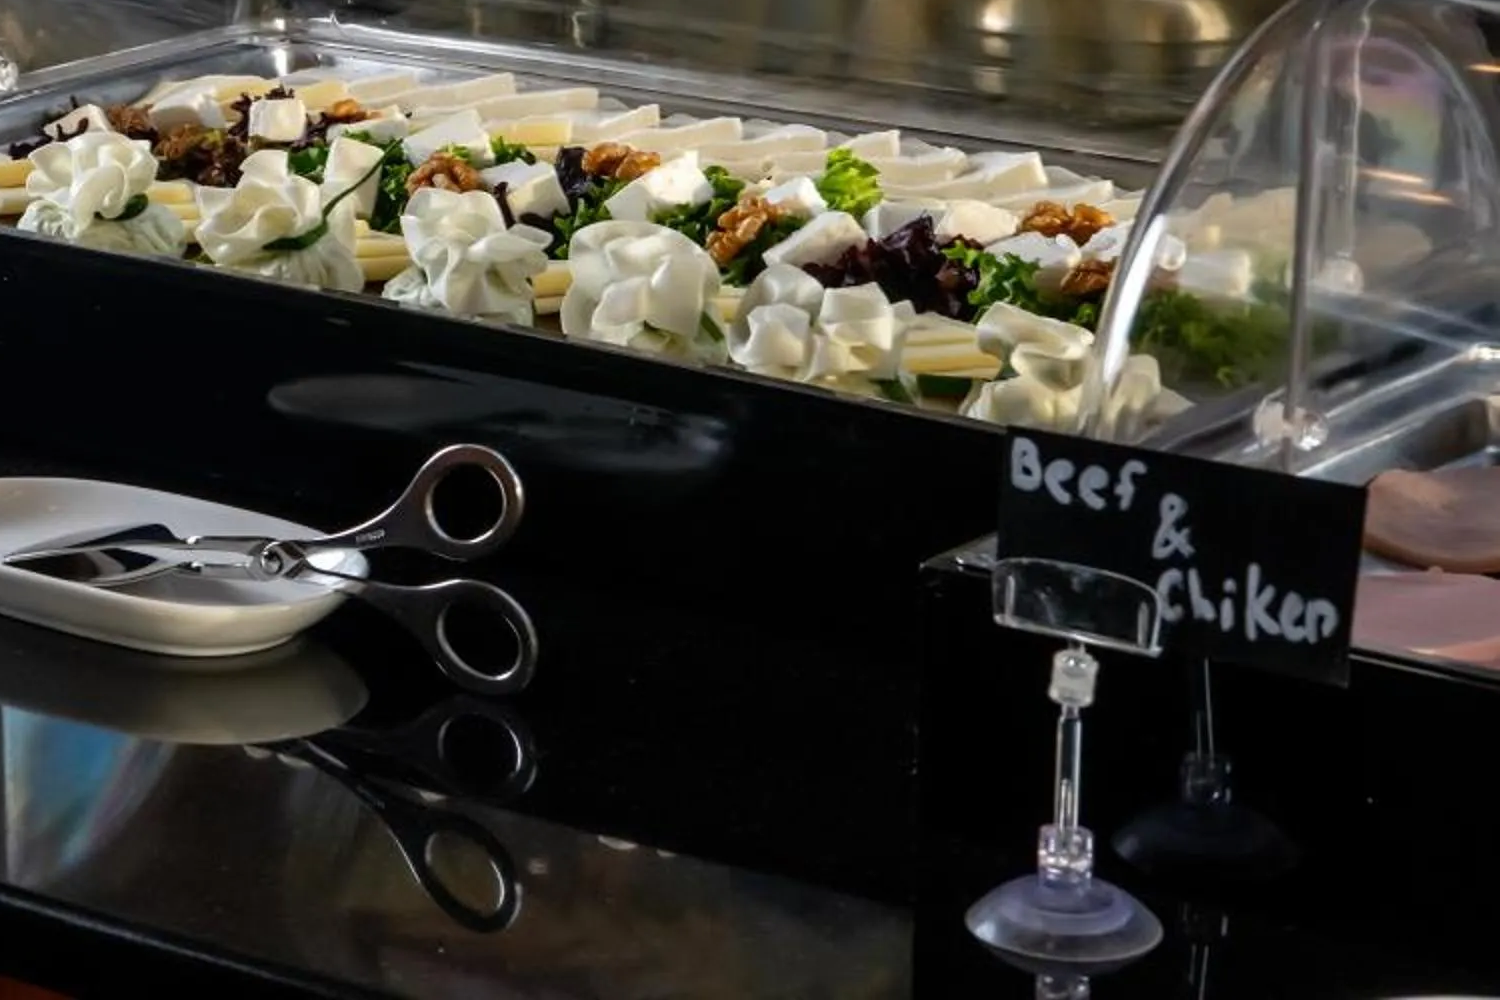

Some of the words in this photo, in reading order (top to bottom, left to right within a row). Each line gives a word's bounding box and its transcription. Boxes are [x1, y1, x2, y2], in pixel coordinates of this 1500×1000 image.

[1011, 436, 1147, 511] Beef
[1152, 493, 1196, 560] &
[1156, 562, 1339, 645] Chiken
